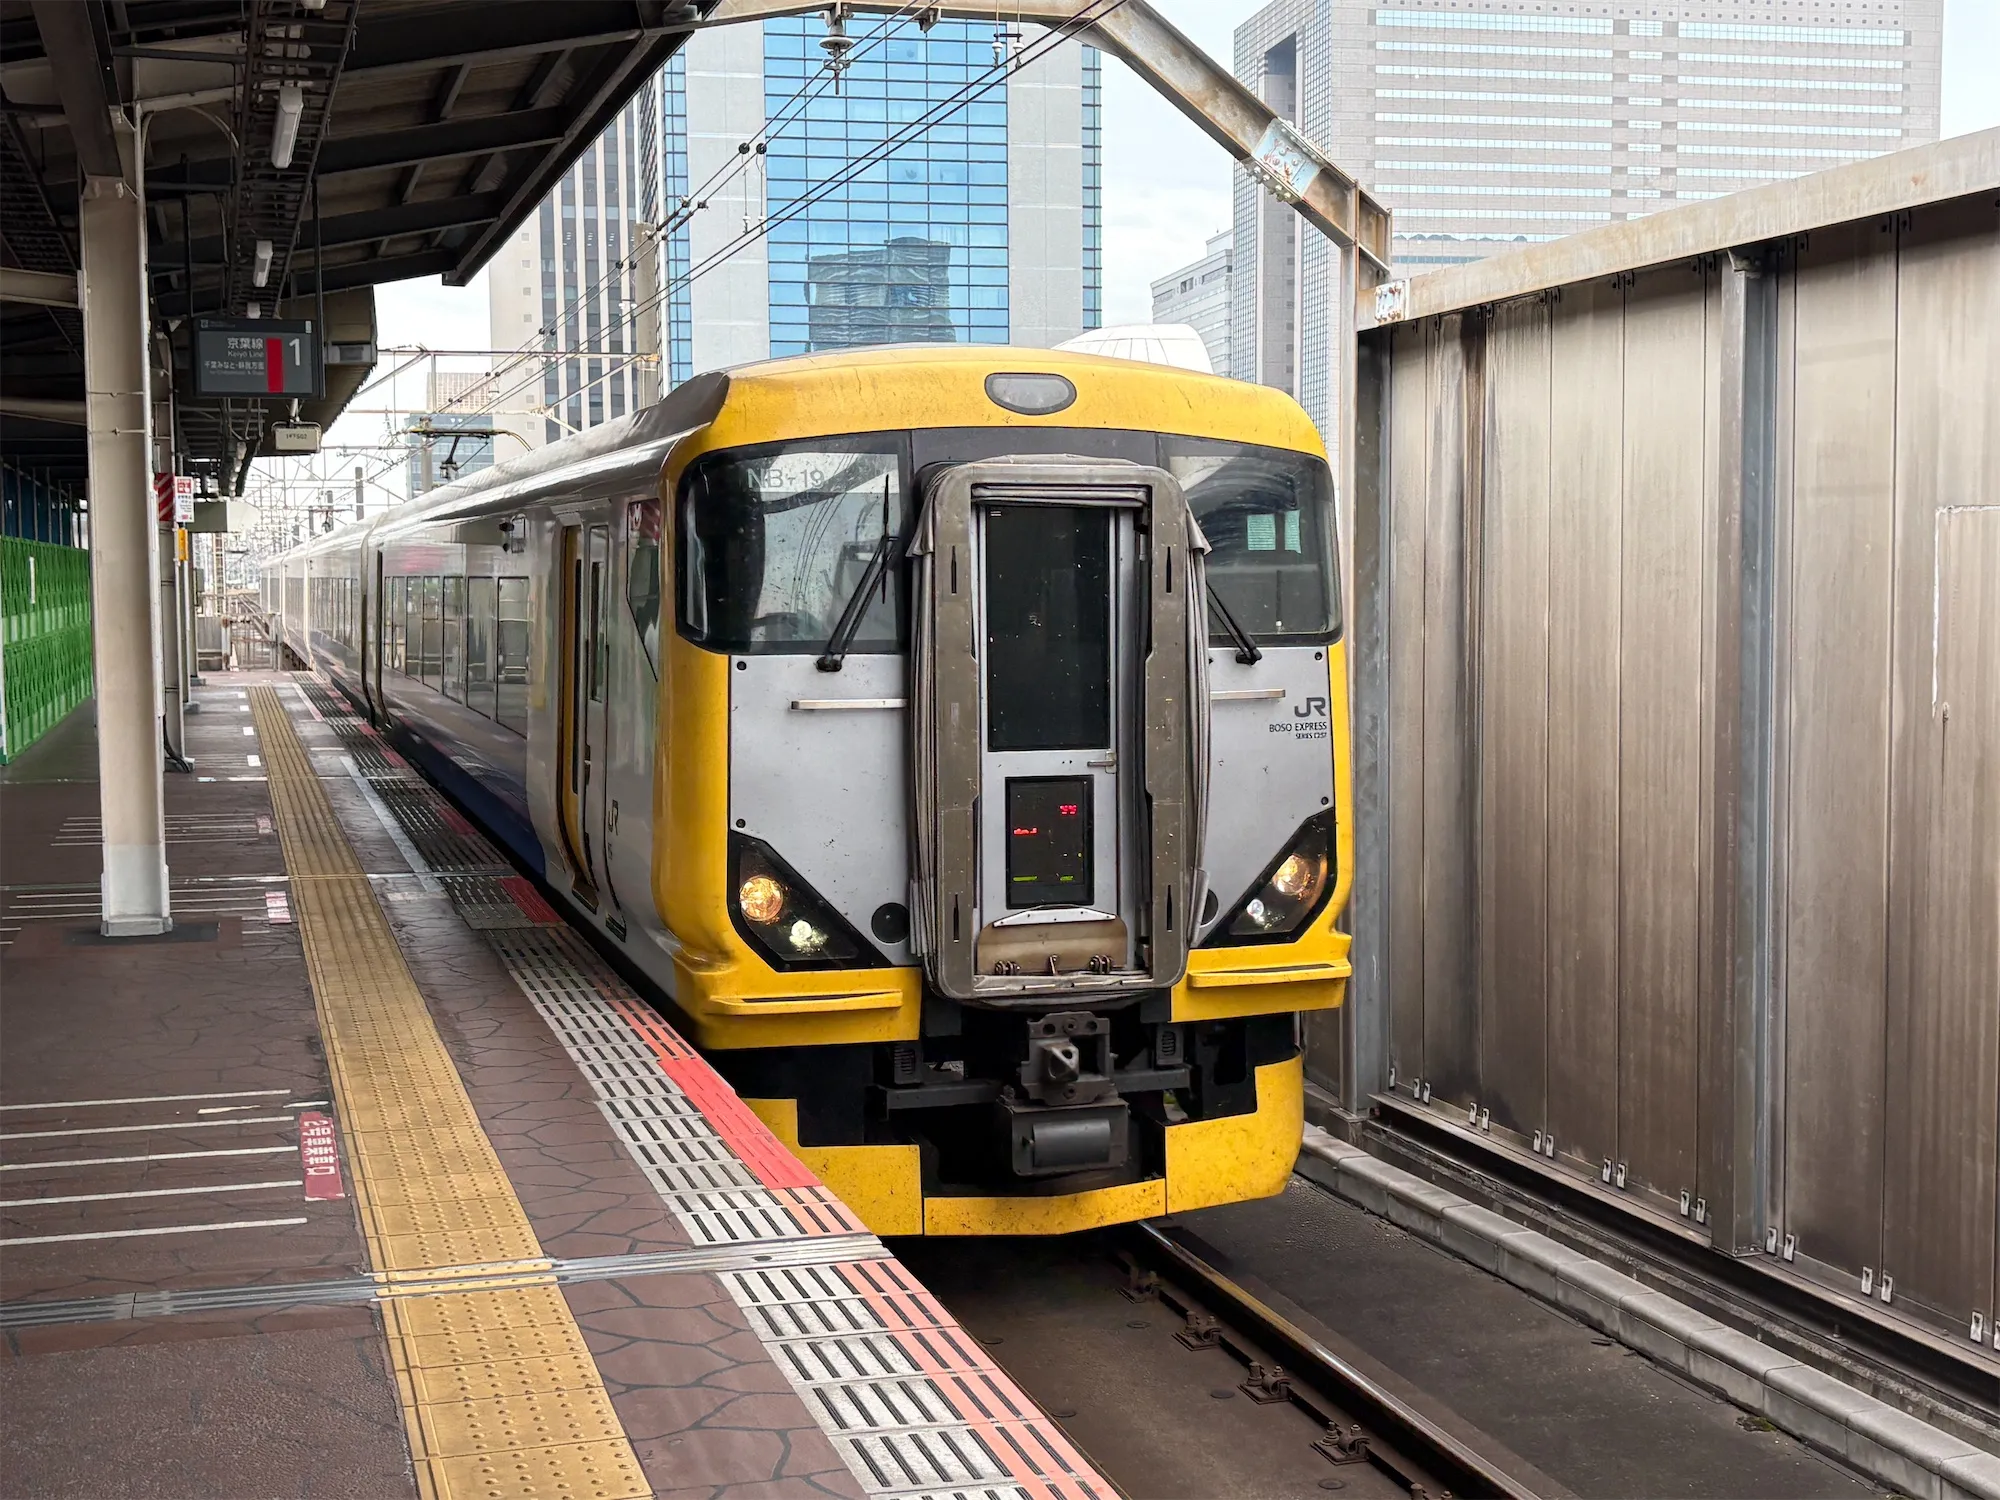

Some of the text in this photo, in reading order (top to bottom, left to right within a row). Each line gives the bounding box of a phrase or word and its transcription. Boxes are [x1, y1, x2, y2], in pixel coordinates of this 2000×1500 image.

[227, 338, 263, 349] 京葉線
[289, 338, 301, 366] 1
[1294, 697, 1326, 718] JR
[1269, 722, 1327, 732] BOSO EXPRESS
[608, 799, 619, 836] JR
